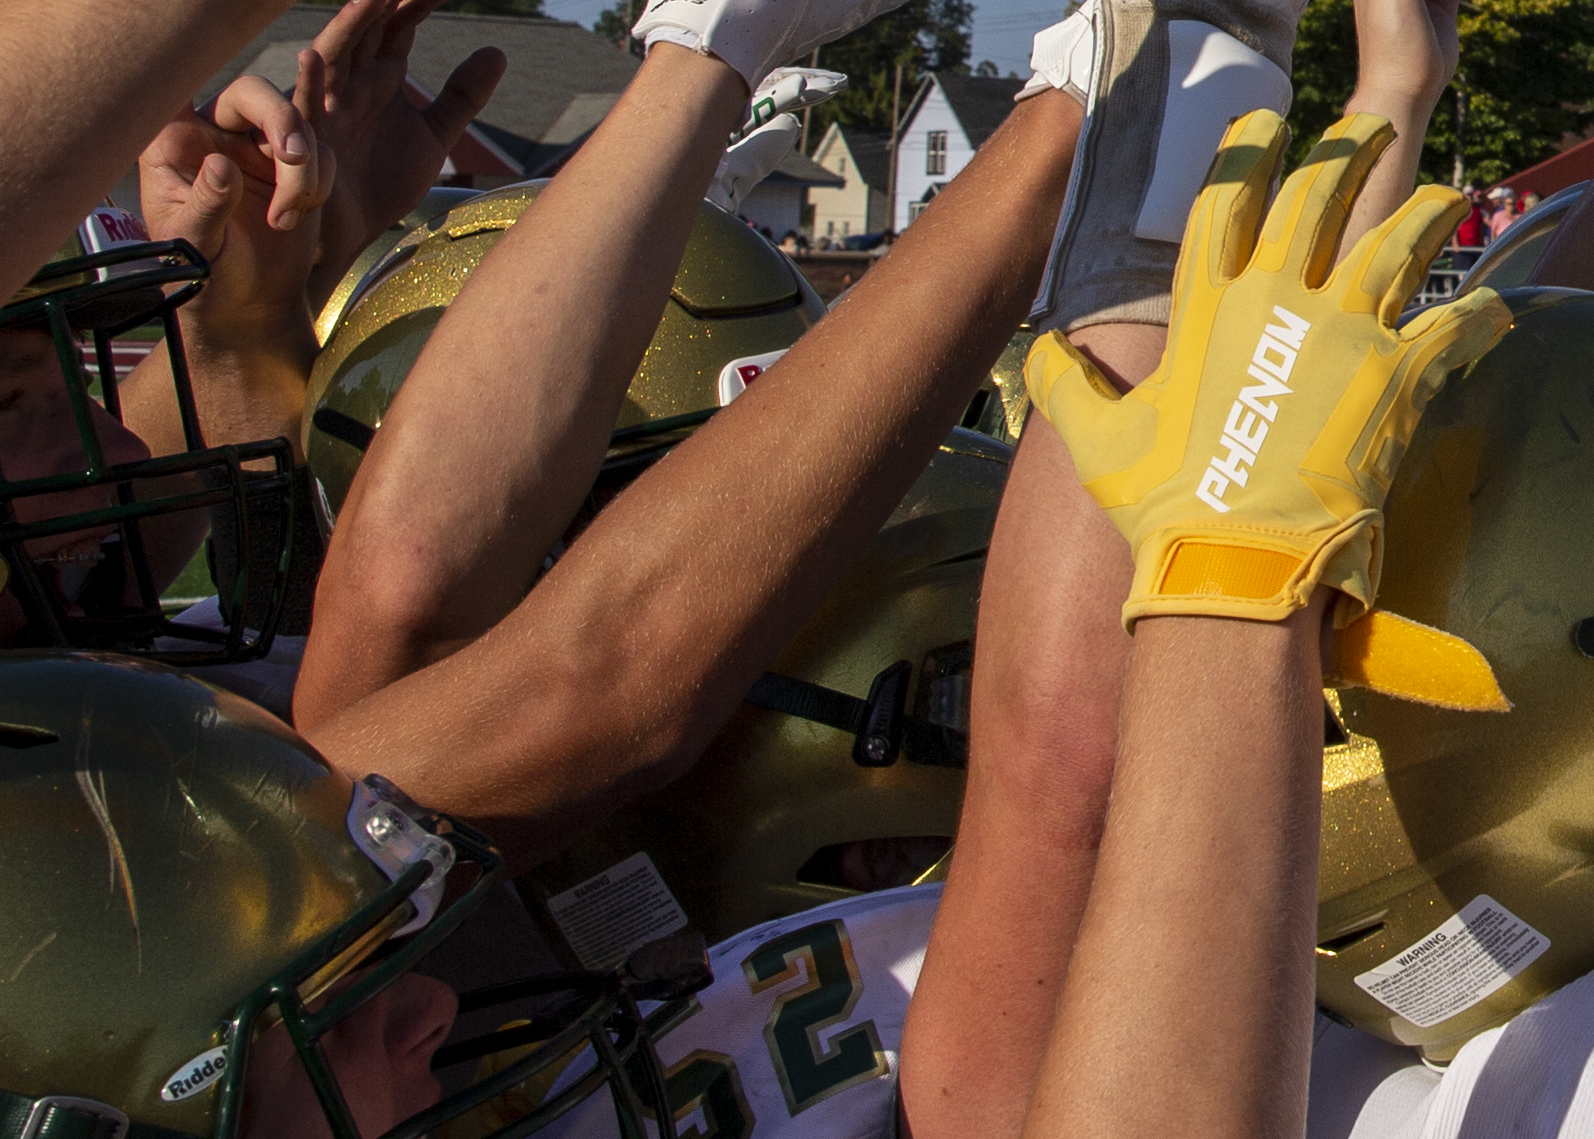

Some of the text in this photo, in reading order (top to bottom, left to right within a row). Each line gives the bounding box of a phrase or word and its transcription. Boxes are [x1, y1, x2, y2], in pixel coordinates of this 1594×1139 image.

[1195, 304, 1312, 514] PHENOM
[1396, 931, 1447, 968] WARNING
[168, 1048, 228, 1099] Ridde
